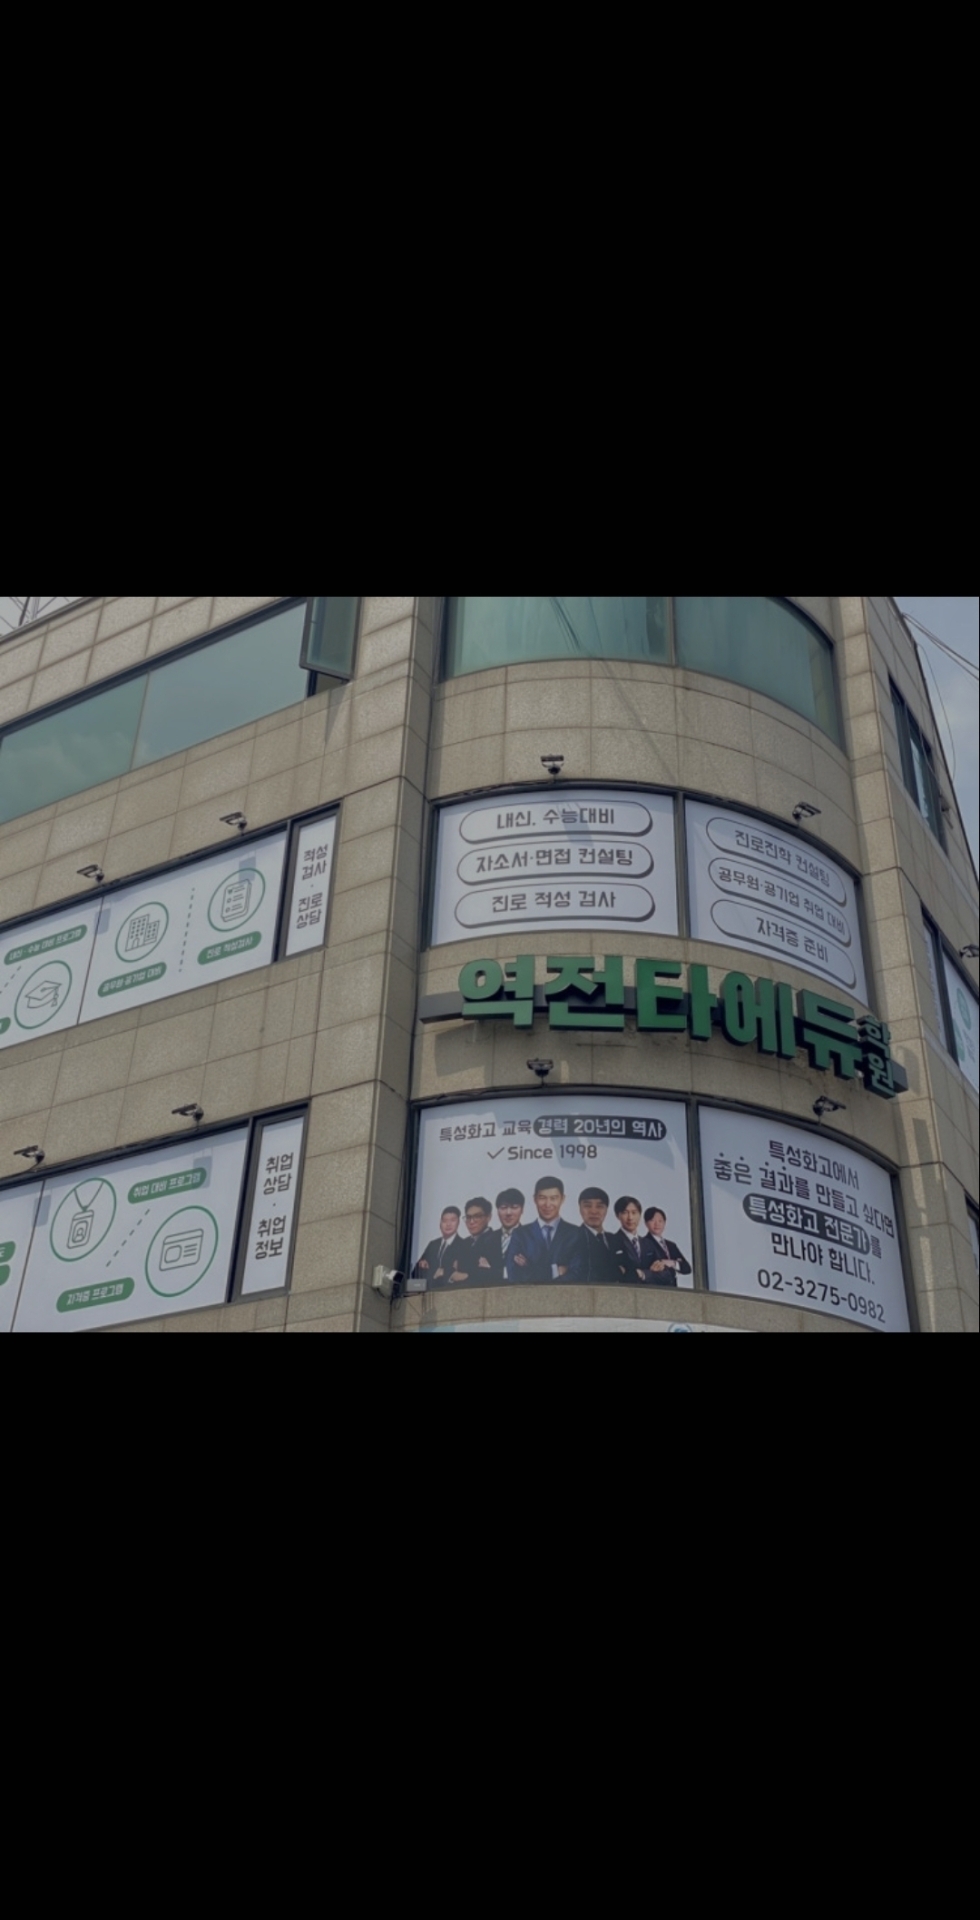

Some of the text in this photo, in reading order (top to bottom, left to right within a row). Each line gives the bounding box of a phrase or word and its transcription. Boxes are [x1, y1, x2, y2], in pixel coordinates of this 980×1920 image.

[543, 807, 615, 826] 수능대비
[303, 844, 328, 862] 적성
[578, 848, 633, 866] 컨설팅
[735, 829, 830, 888] 진로진학 컨설팅
[302, 860, 327, 881] 검사
[298, 892, 323, 913] 진로
[492, 891, 616, 913] 진로 적성 검사
[296, 909, 322, 930] 상담
[804, 898, 825, 921] 취업
[827, 912, 845, 936] 대비
[756, 917, 829, 963] 자격증 준비
[458, 954, 864, 1080] 역전타에듀
[857, 1014, 898, 1100] 학원
[439, 1117, 664, 1142] 특성화고 교육 경력 20년의 역사
[265, 1152, 294, 1175] 취업
[507, 1144, 598, 1160] Since 1998
[769, 1139, 860, 1191] 특성화고에서
[263, 1173, 292, 1196] 상담
[713, 1158, 895, 1239] 좋은 결과를 만들고 싶다면
[257, 1215, 286, 1238] 취업
[748, 1195, 819, 1235] 특성화고
[255, 1237, 284, 1260] 정보
[771, 1232, 876, 1285] 만나야 합니다.
[757, 1268, 886, 1324] 02-3275-0982
